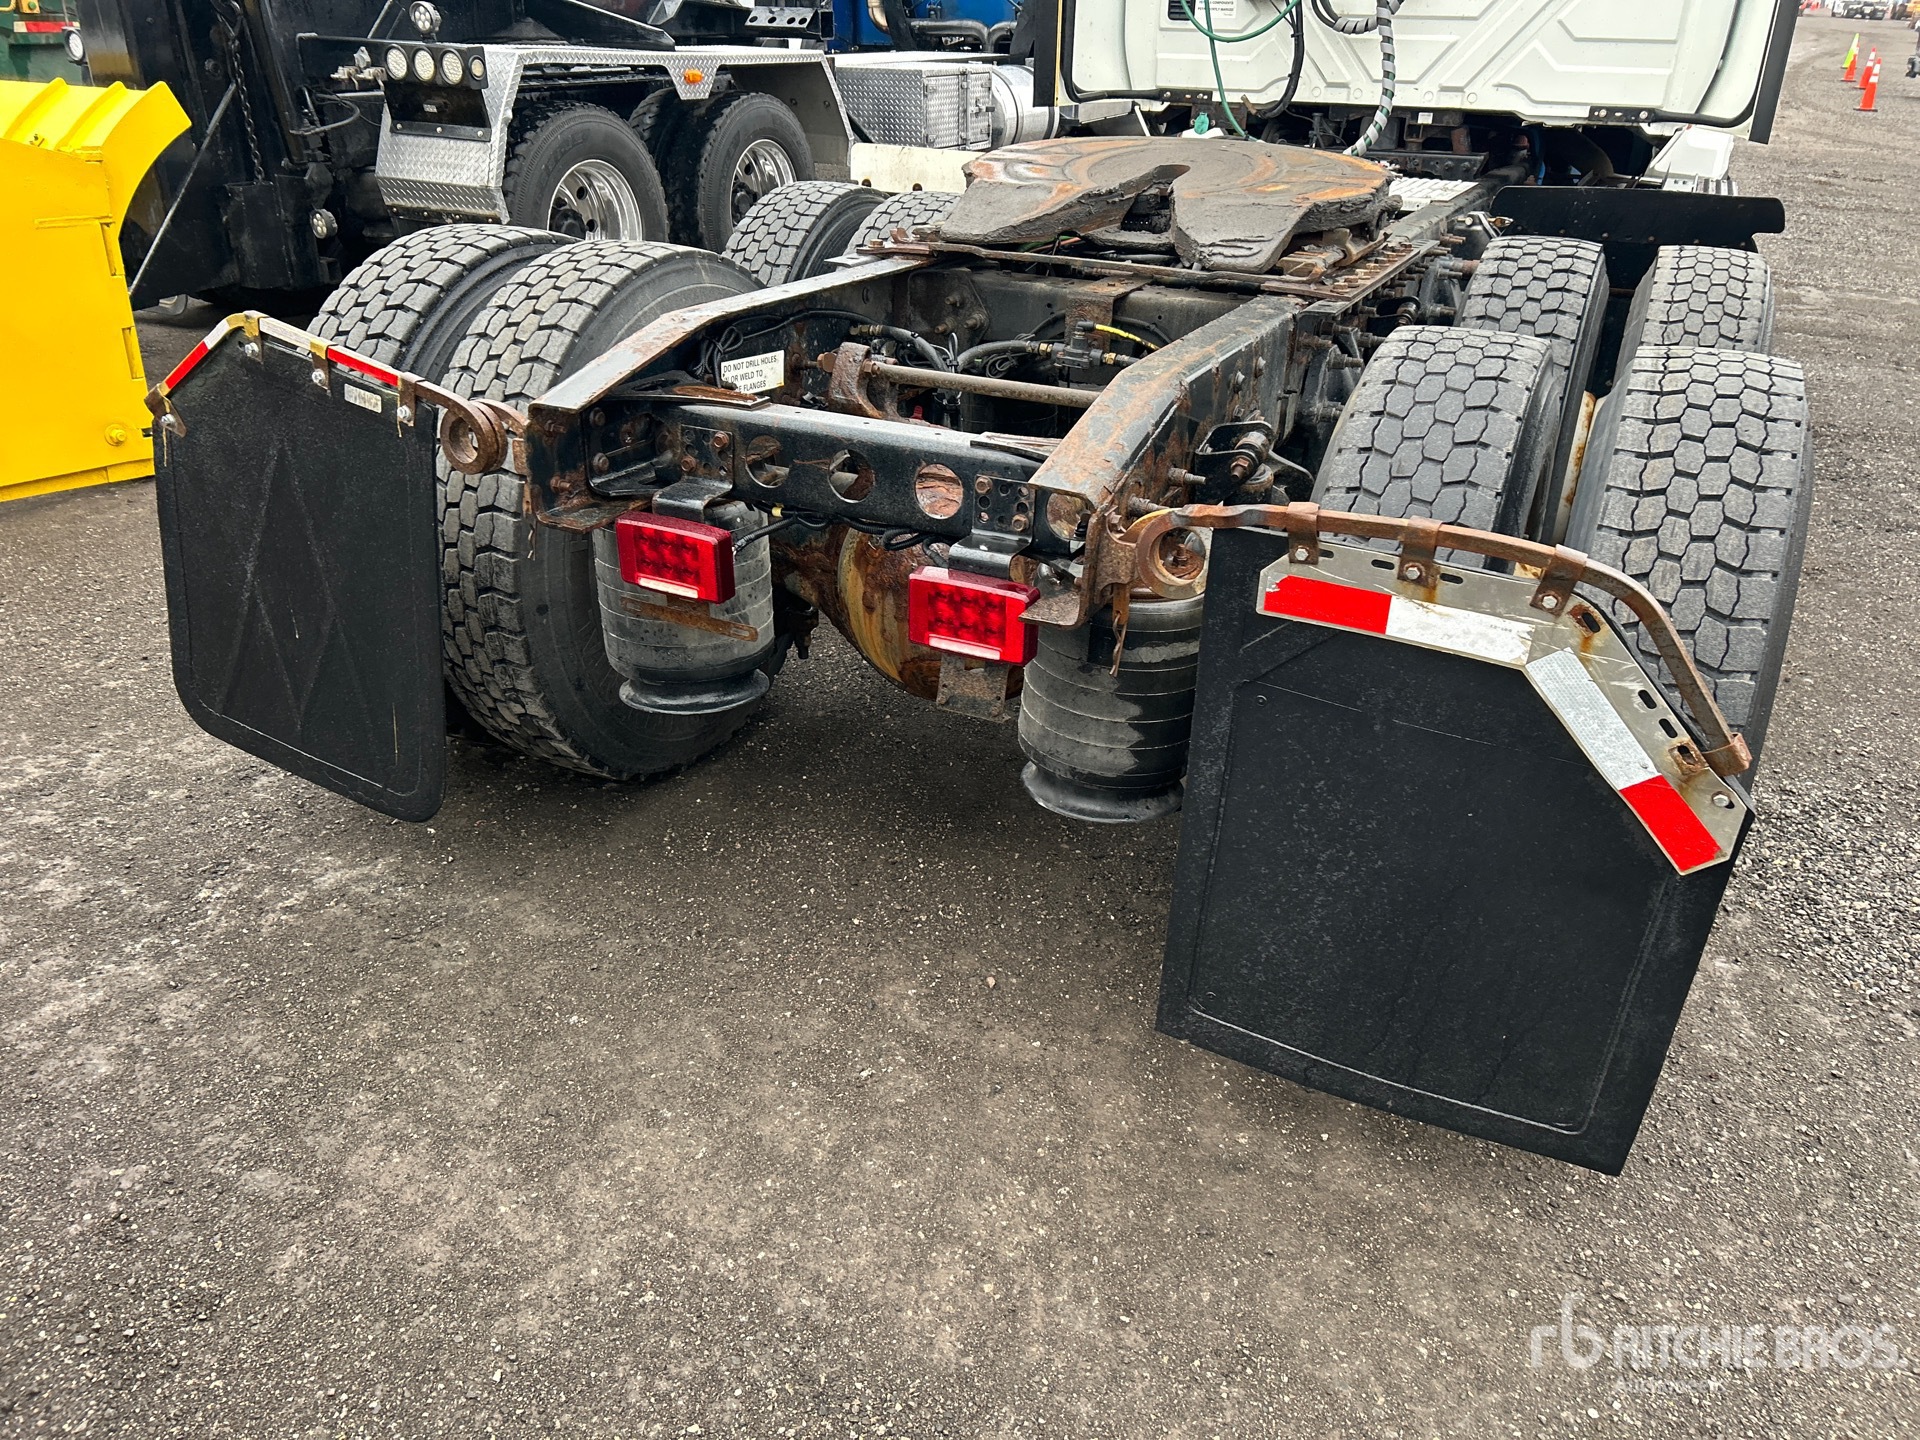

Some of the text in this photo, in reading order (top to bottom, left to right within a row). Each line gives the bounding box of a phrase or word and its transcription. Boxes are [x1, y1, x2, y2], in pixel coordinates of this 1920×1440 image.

[723, 355, 777, 373] DO NOT DRILL HOLES
[740, 371, 755, 381] WELD
[756, 369, 764, 377] TO
[743, 380, 766, 391] FLANGES
